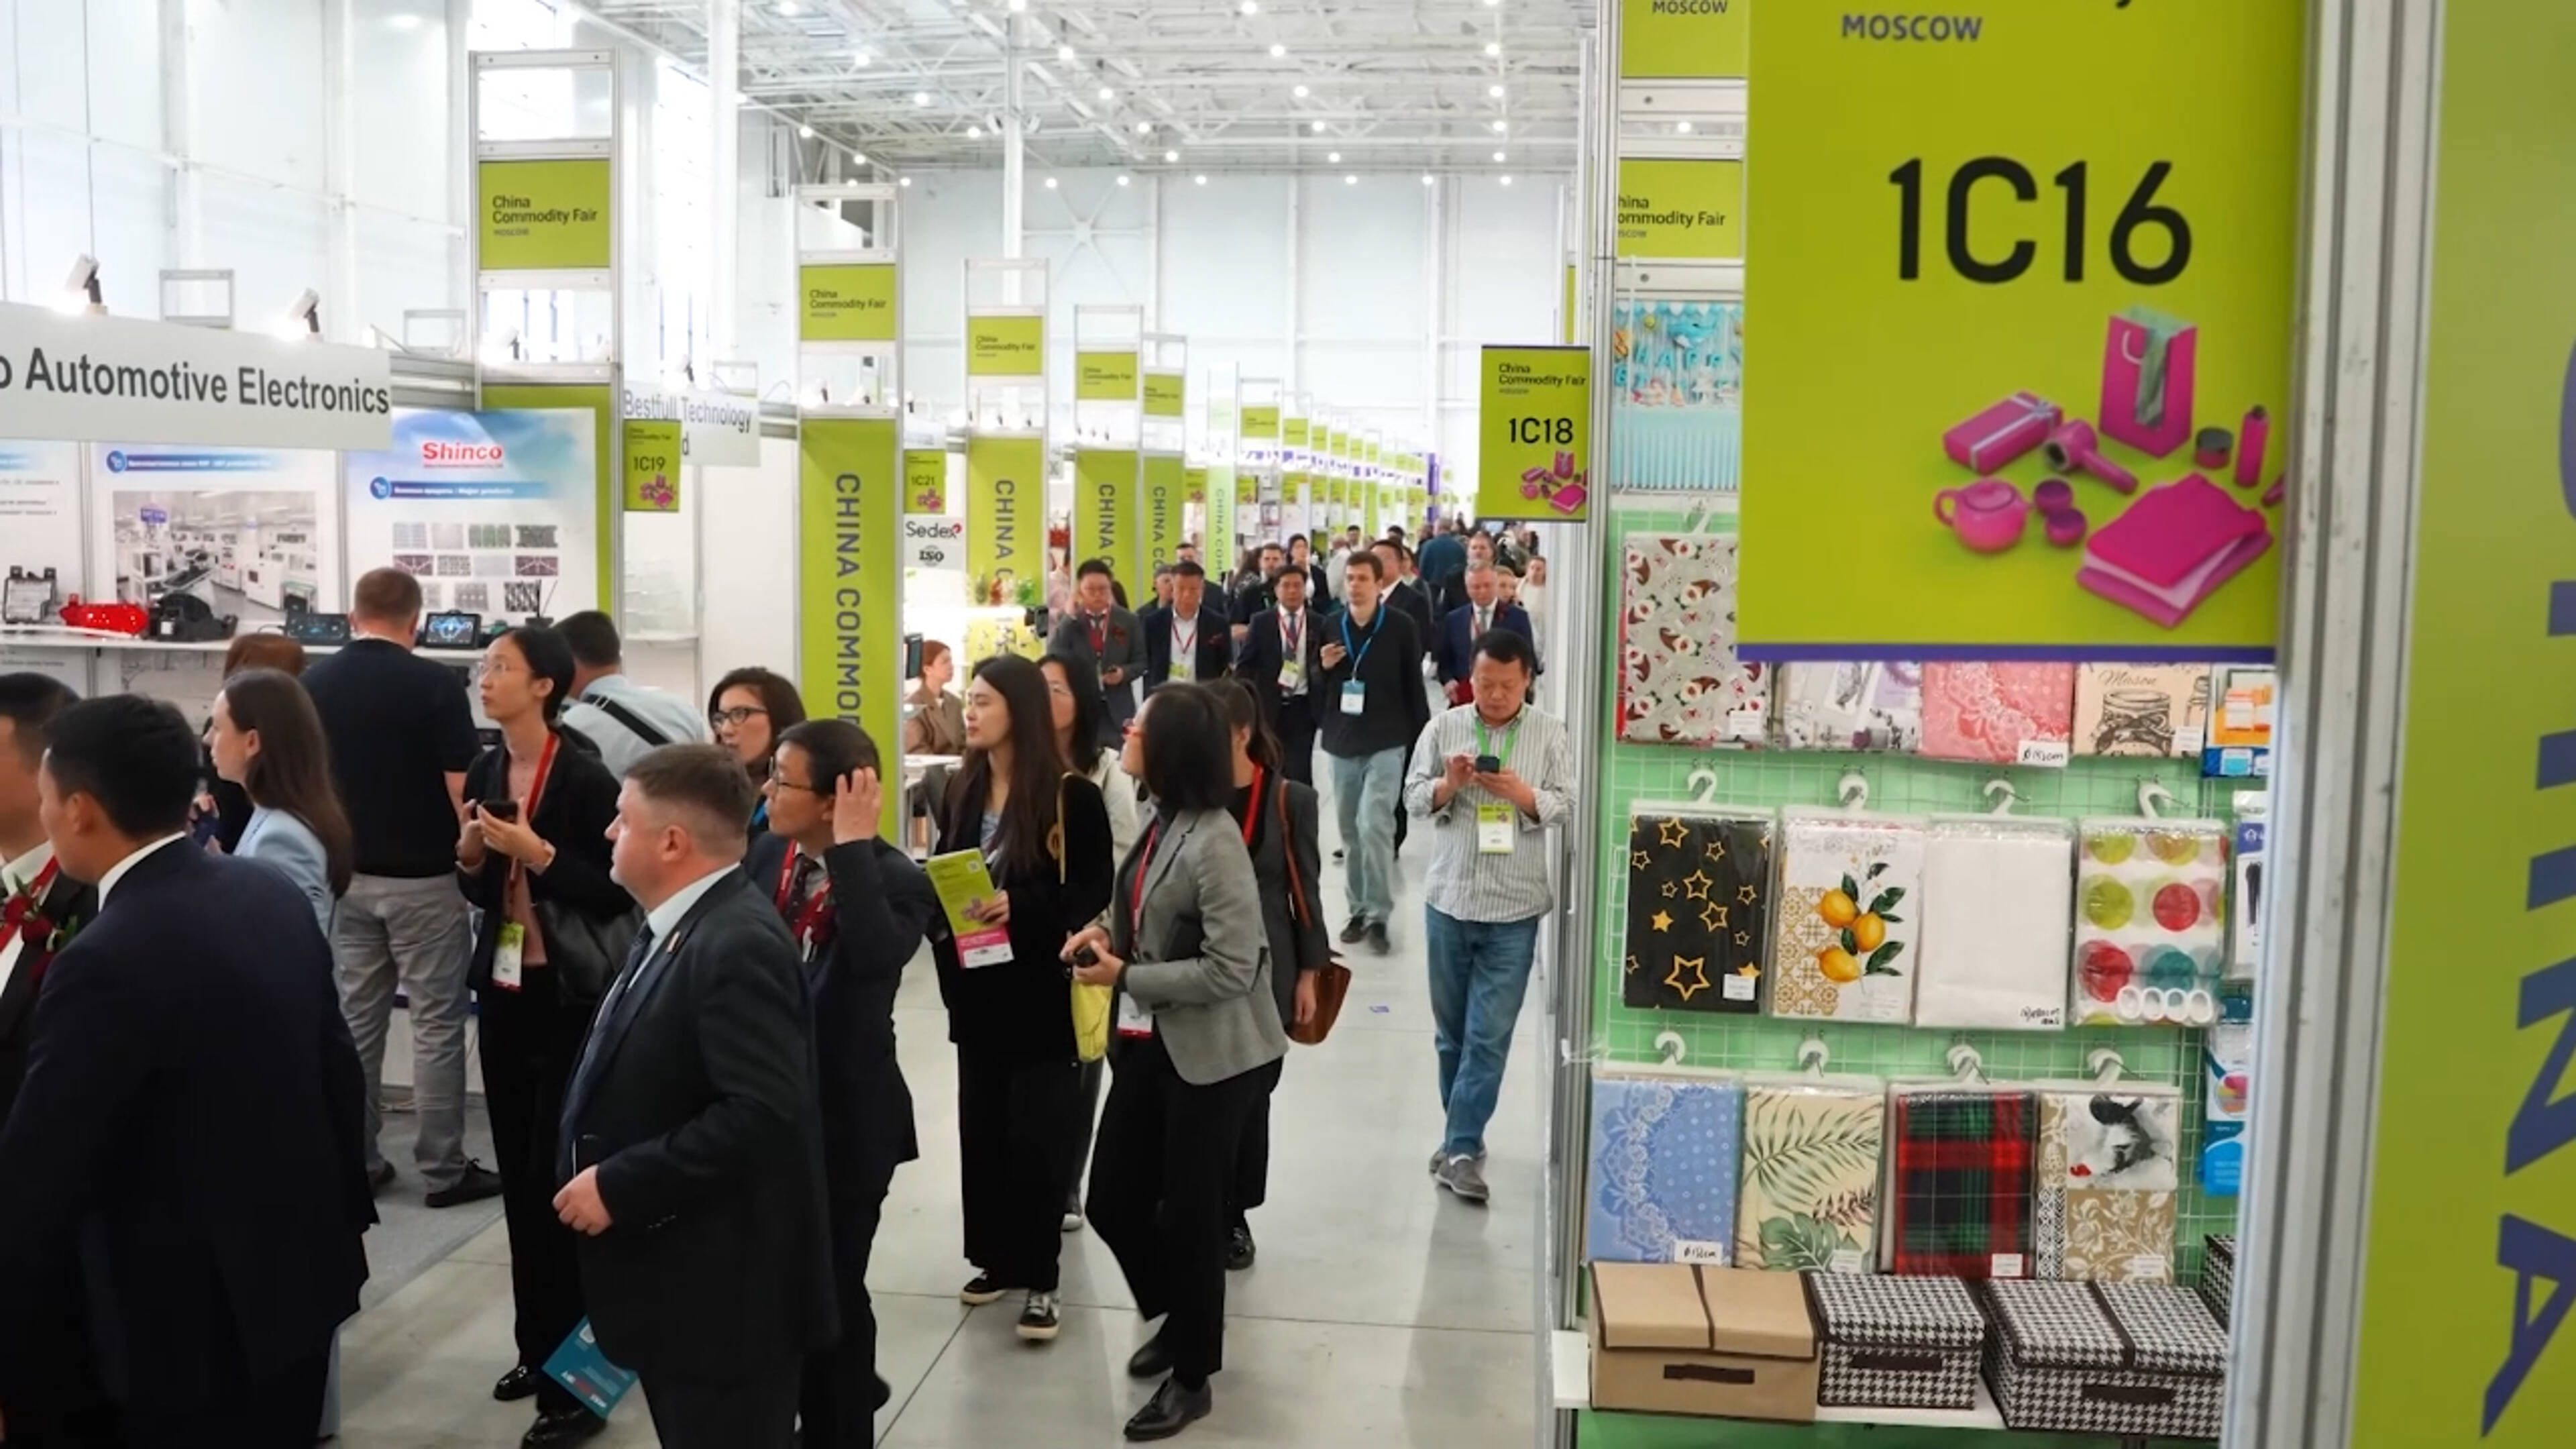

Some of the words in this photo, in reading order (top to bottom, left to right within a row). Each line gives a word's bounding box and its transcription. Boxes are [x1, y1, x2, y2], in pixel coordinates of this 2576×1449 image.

[1652, 0, 1728, 14] MOSCOW
[1841, 14, 1983, 42] MOSCOW
[492, 195, 531, 208] China
[1618, 195, 1649, 209] hina
[492, 210, 570, 225] Commodity
[572, 209, 598, 222] Fair
[1617, 211, 1693, 229] ommodity
[1698, 211, 1726, 225] Fair
[1889, 156, 2192, 286] 1C16
[1499, 363, 1530, 373] China
[25, 347, 227, 403] Automotive
[238, 366, 389, 414] Electronics
[1499, 374, 1563, 388] Commodity
[1565, 375, 1587, 386] Fair
[682, 396, 751, 433] Technology
[1509, 417, 1574, 445] 1C18
[423, 442, 503, 460] Shinco
[633, 456, 666, 472] 1C19
[996, 480, 1014, 560] CHINA
[1098, 484, 1116, 549] CHINA
[1153, 486, 1166, 542] CHINA
[836, 474, 861, 578] CHINA
[906, 521, 957, 539] Sedex
[919, 550, 945, 562] ISO
